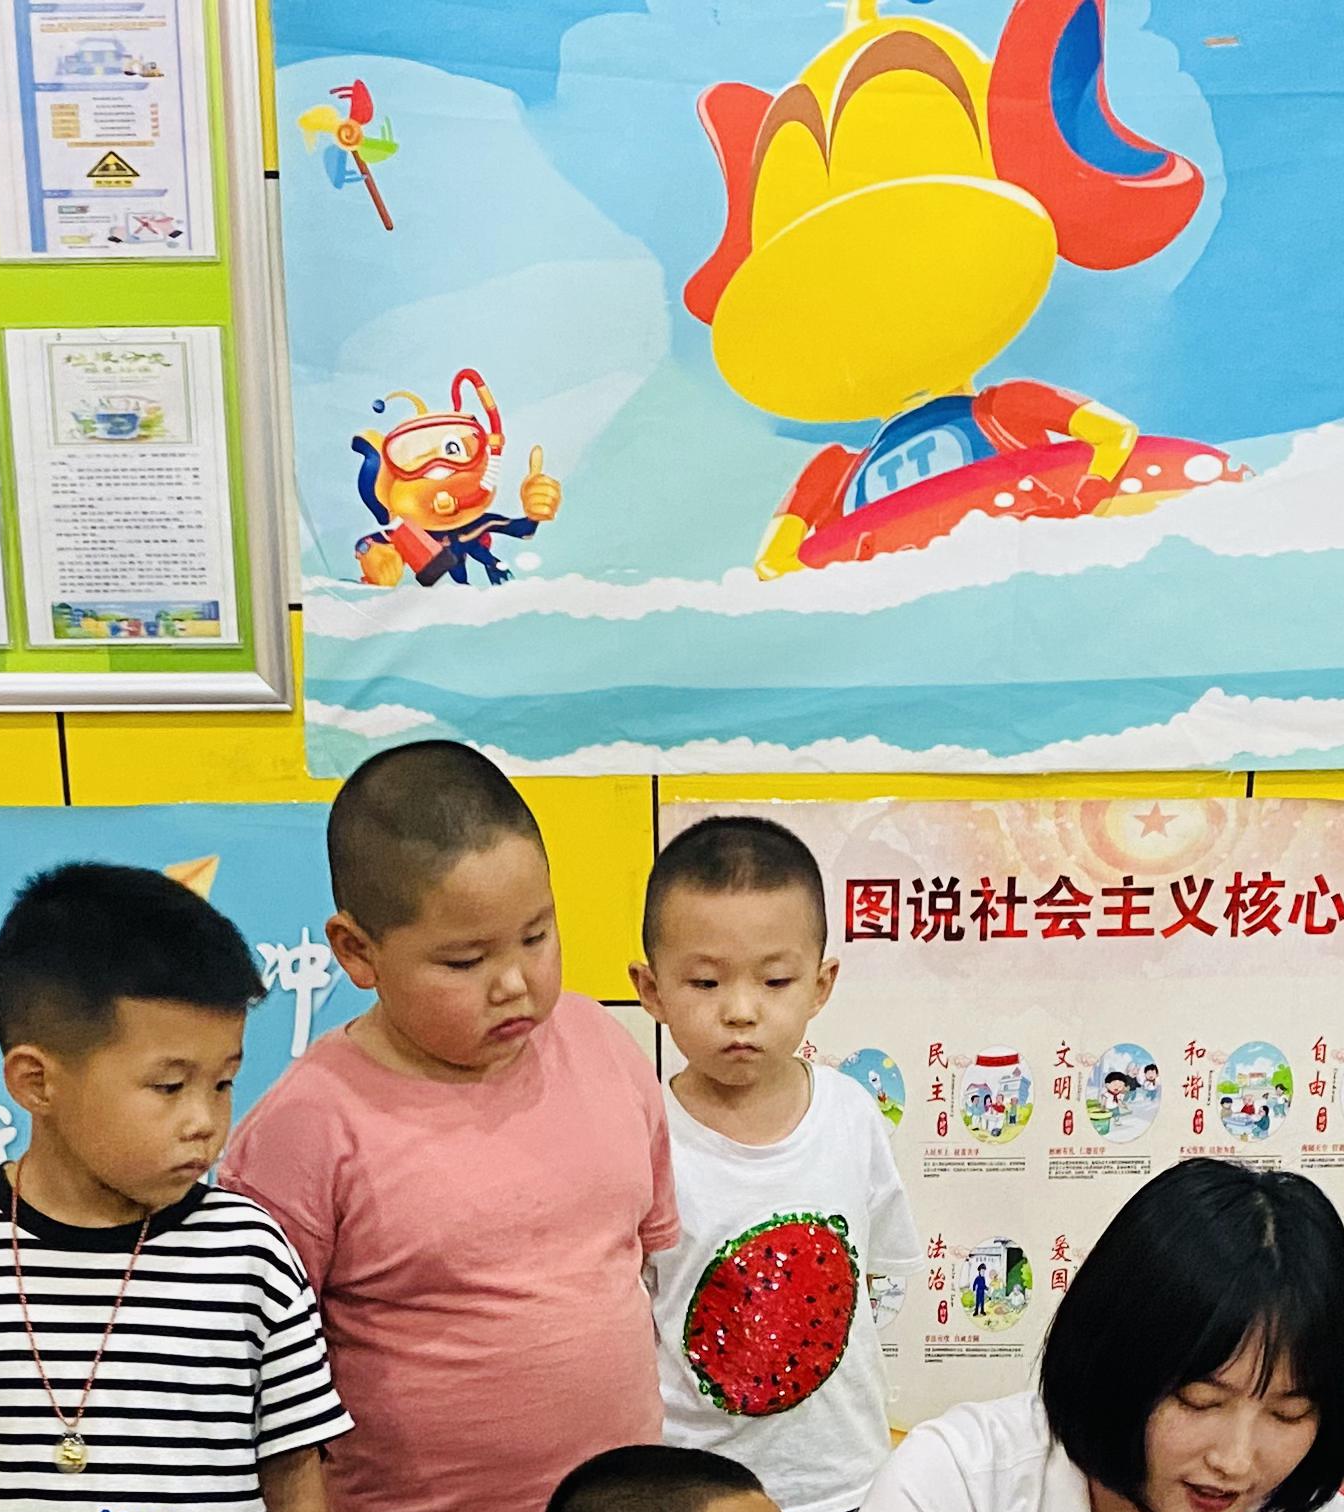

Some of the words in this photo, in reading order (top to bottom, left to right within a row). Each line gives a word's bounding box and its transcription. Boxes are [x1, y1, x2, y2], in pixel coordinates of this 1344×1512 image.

[926, 1042, 950, 1103] 民主
[1053, 1040, 1075, 1101] 文明
[1182, 1039, 1207, 1101] 和谐
[1308, 1036, 1329, 1098] 自由
[927, 1233, 947, 1291] 法治
[1050, 1234, 1072, 1293] 爱国
